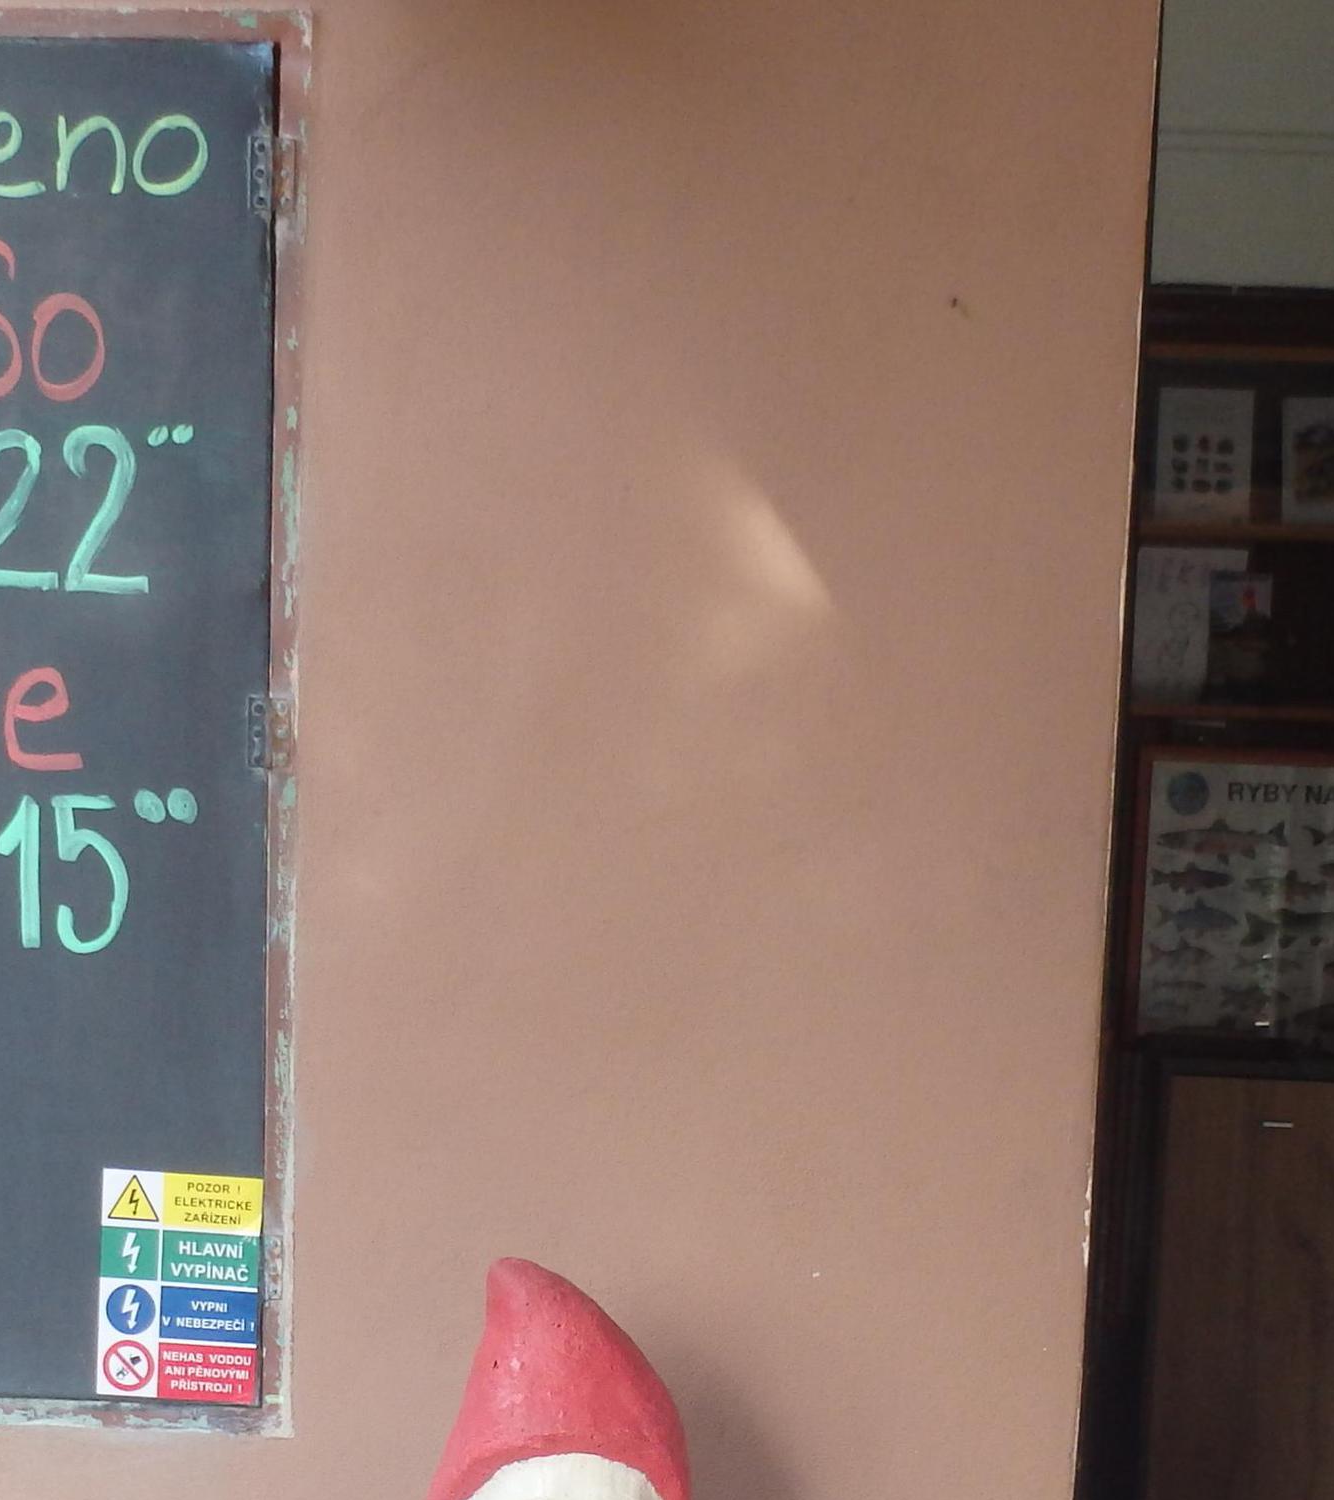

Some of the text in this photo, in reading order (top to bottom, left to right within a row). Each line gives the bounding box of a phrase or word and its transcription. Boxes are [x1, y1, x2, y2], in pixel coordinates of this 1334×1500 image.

[1227, 781, 1298, 804] RYBY
[187, 1182, 230, 1194] POZOR
[184, 1211, 241, 1225] ZAŘÍZENÍ
[178, 1240, 244, 1259] HLAVNÍ
[170, 1261, 249, 1282] VYPÍNAČ
[191, 1300, 228, 1313] VYPNI
[162, 1315, 171, 1326] V
[176, 1316, 245, 1331] NEBEZPEČÍ
[209, 1353, 252, 1366] VODOU
[164, 1365, 249, 1380] ANI PĚNOVÝMI
[170, 1378, 232, 1393] PŘÍSTROJI
